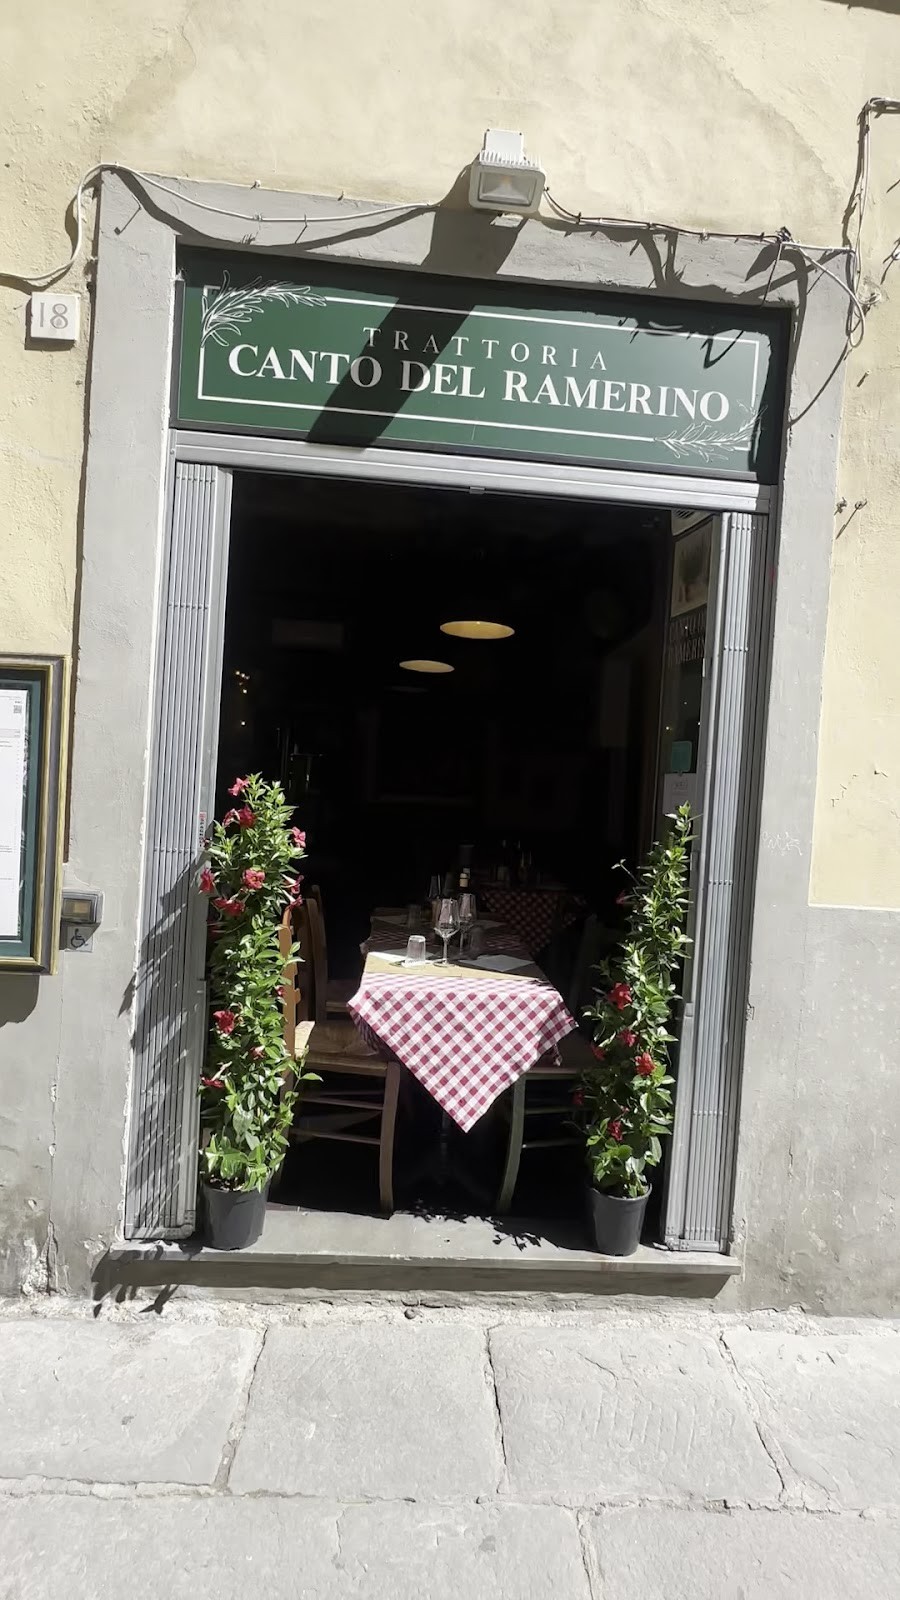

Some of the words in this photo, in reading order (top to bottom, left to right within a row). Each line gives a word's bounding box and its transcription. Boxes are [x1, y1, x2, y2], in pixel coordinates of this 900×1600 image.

[39, 302, 69, 330] 18
[362, 326, 609, 371] TRATTORIA
[228, 343, 383, 389] CANTO
[400, 359, 486, 399] DEL
[501, 369, 730, 422] RAMERINO
